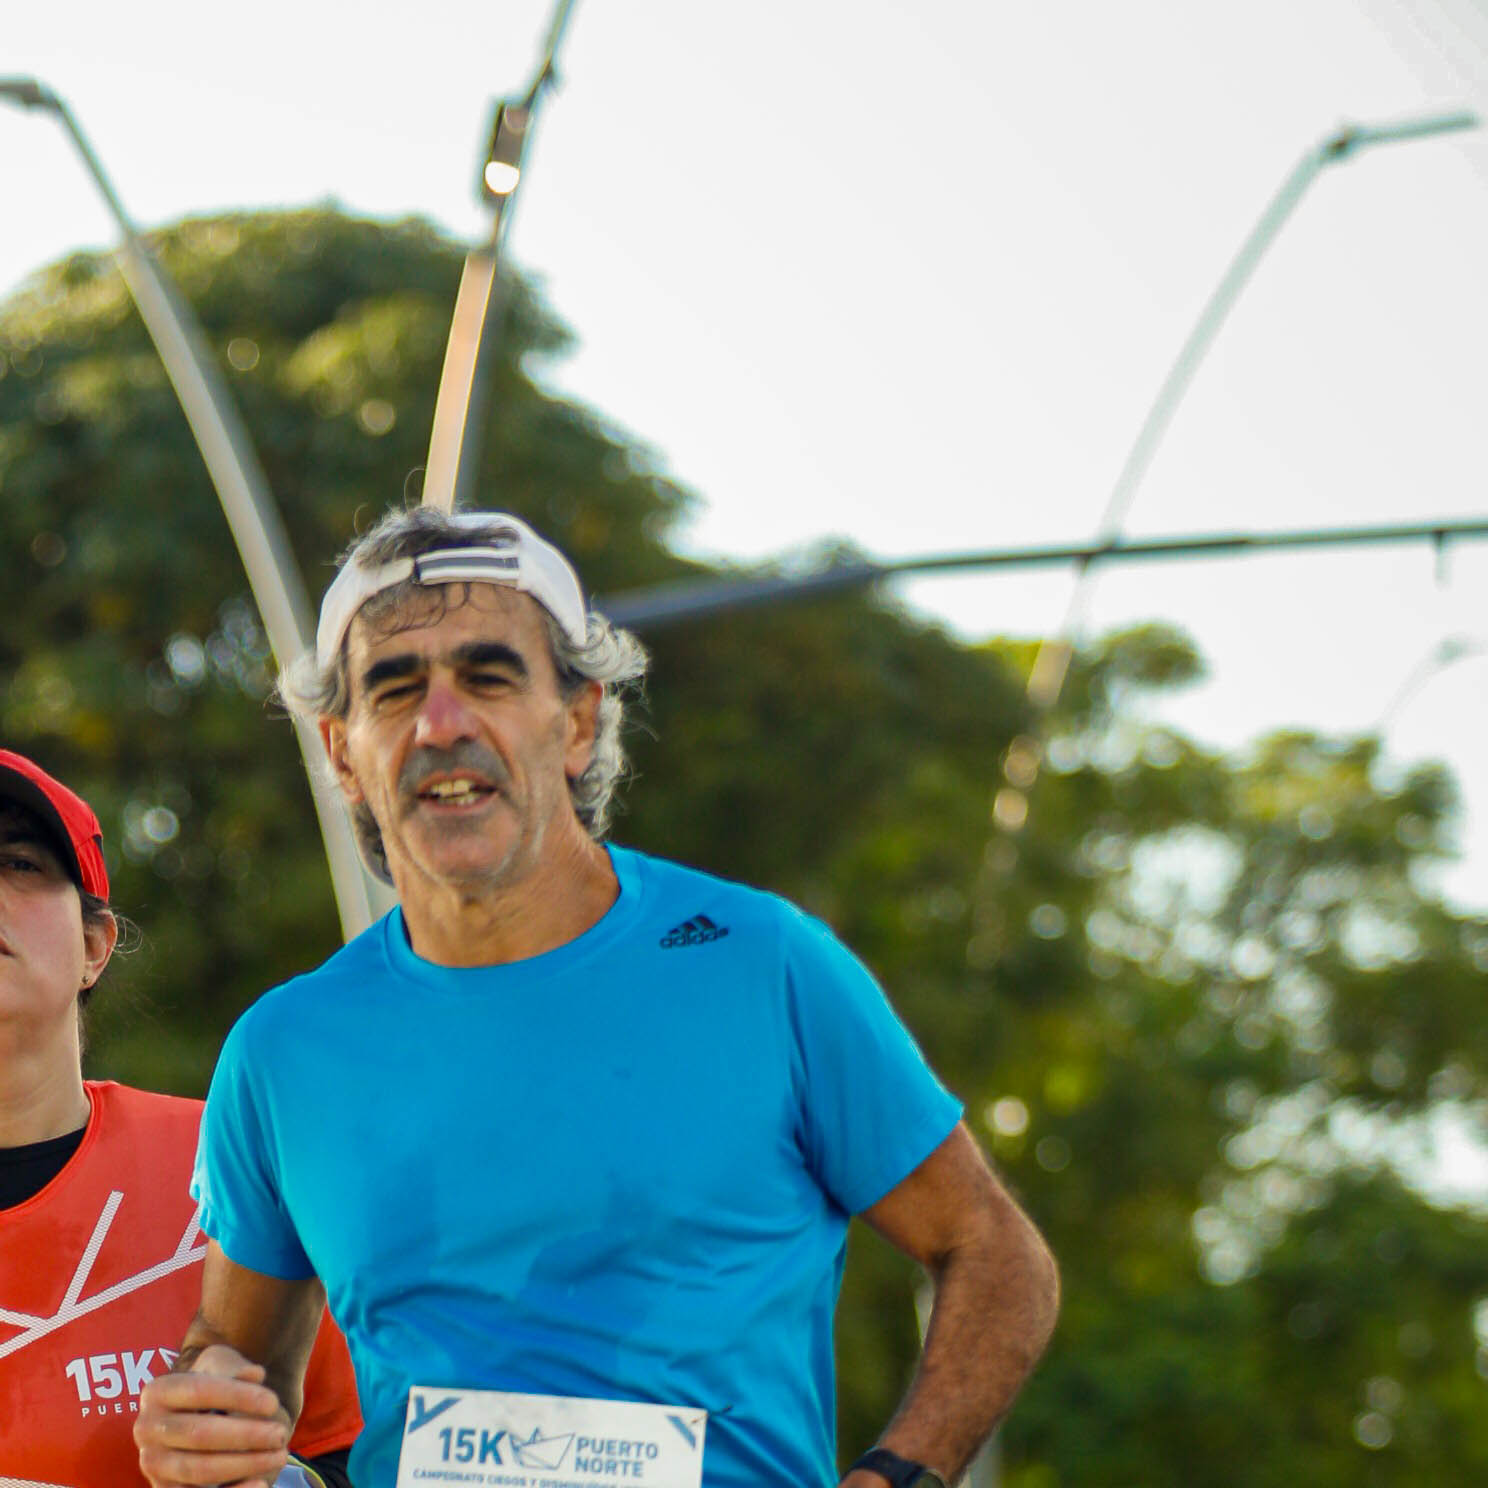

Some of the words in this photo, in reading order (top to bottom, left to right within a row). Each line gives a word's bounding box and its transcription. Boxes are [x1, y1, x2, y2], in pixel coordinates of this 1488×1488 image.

[659, 926, 730, 949] adidas
[65, 1349, 156, 1402] 15K
[81, 1401, 139, 1418] PUER
[438, 1426, 508, 1466] 15K
[576, 1436, 659, 1460] PUERTO
[574, 1456, 644, 1478] NORTE
